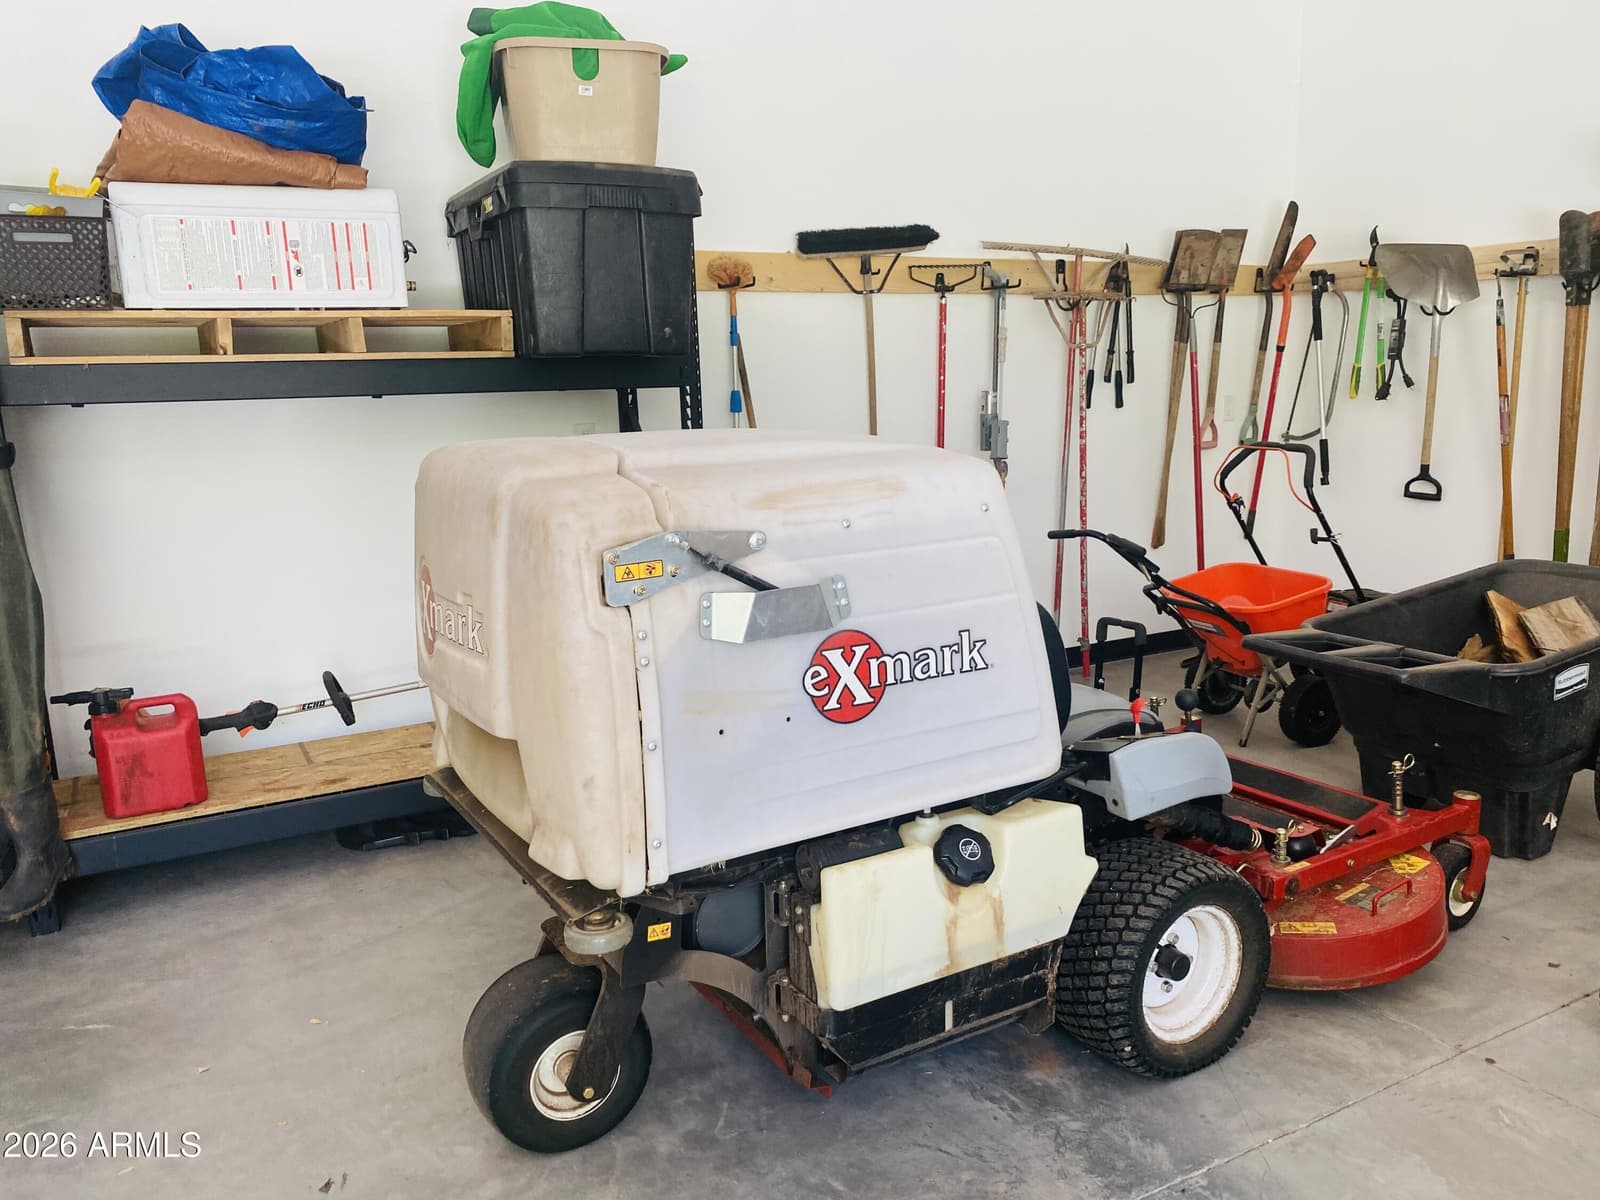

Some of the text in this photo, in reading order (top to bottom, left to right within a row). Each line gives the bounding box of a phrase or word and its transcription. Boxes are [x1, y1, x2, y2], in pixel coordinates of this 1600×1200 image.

[419, 579, 485, 655] Xmark
[302, 699, 326, 711] ECHO
[803, 629, 988, 711] eXmark
